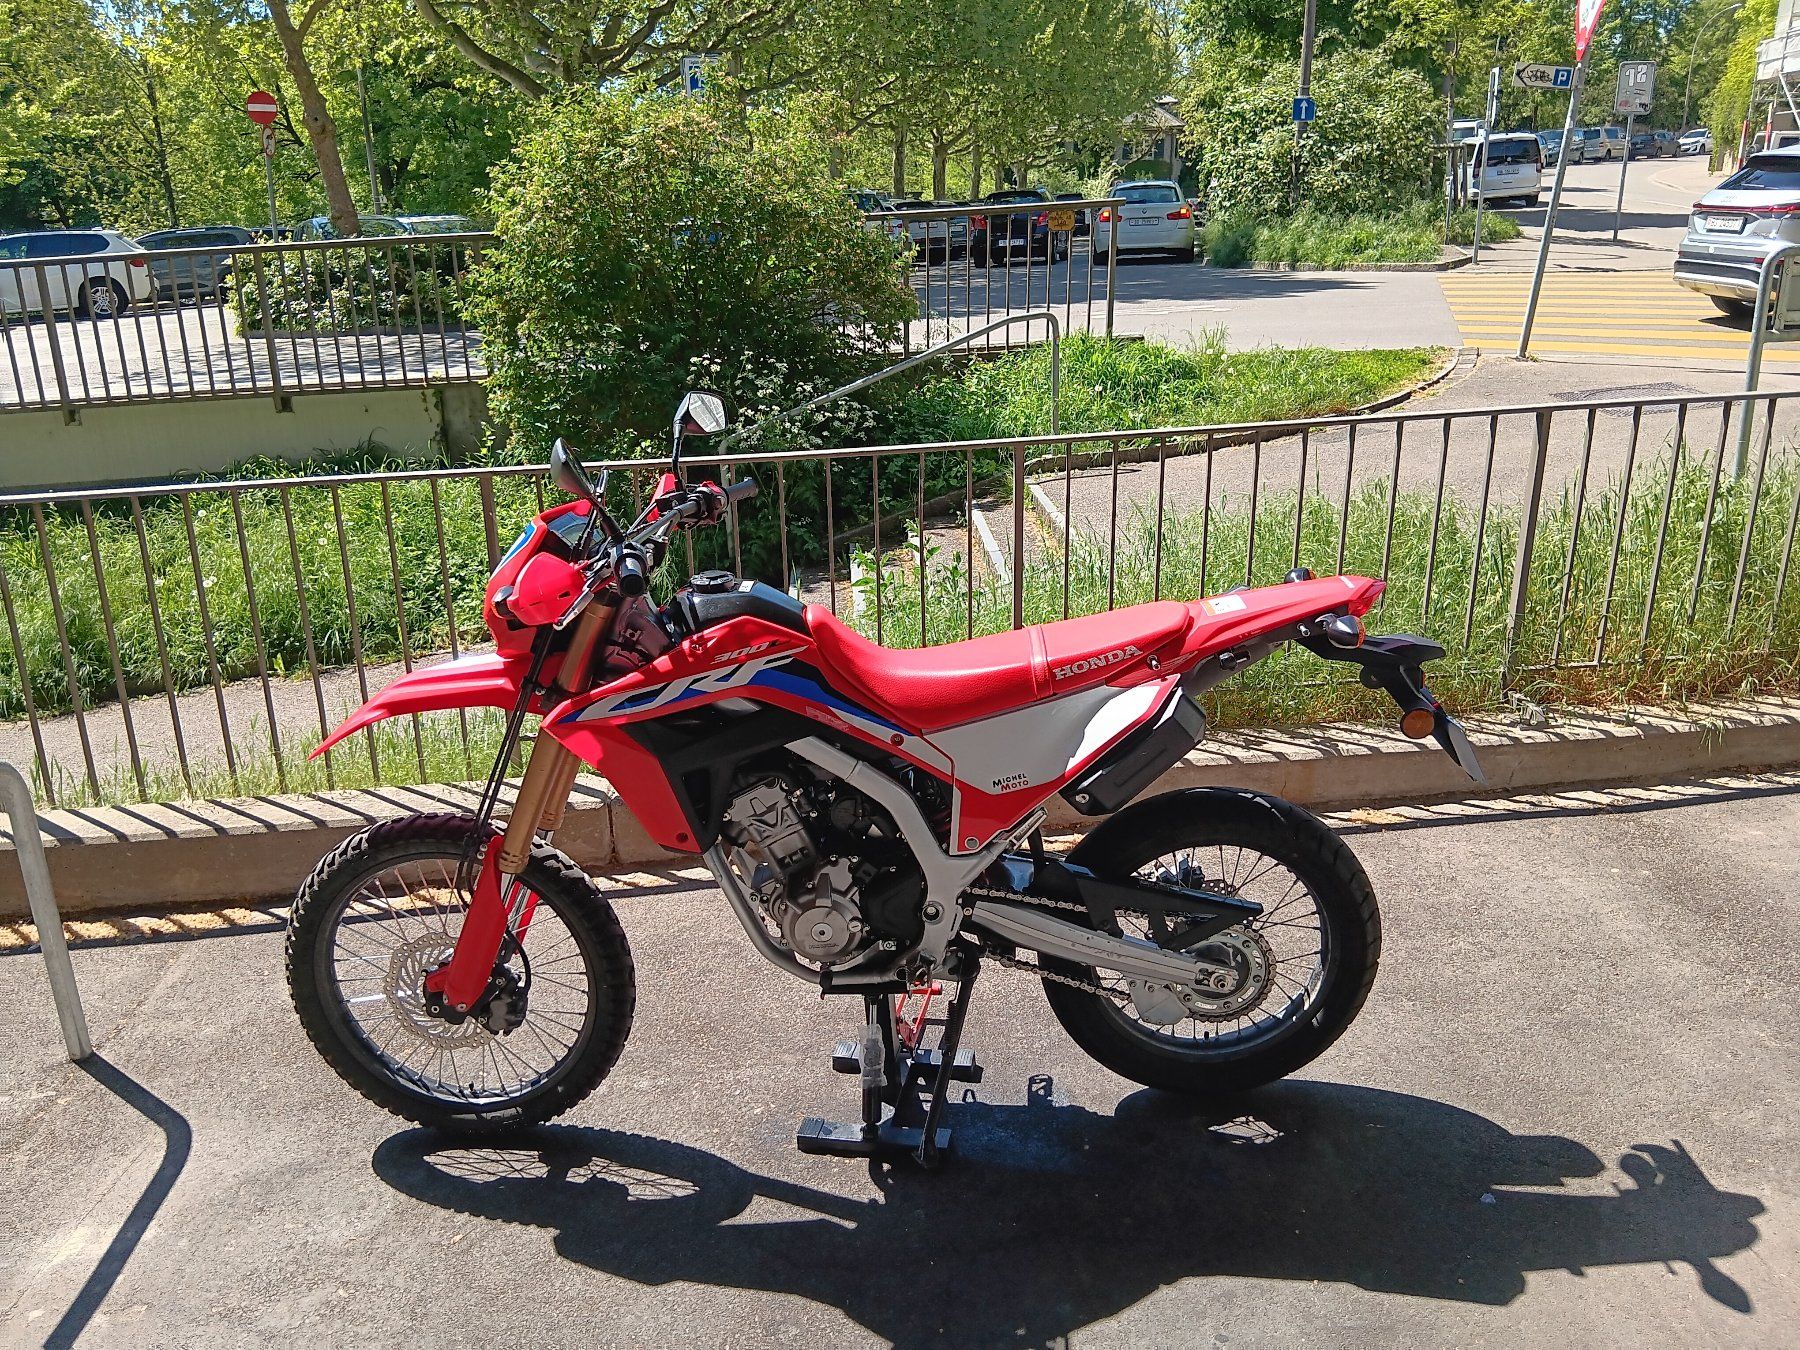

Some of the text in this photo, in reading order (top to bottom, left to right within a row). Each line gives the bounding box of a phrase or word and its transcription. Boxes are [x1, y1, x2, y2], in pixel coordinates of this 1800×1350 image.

[1557, 71, 1568, 85] P
[1052, 645, 1143, 680] HONDA
[576, 645, 810, 722] CRF
[992, 773, 1027, 788] MICHEL
[1000, 780, 1029, 791] MOTO
